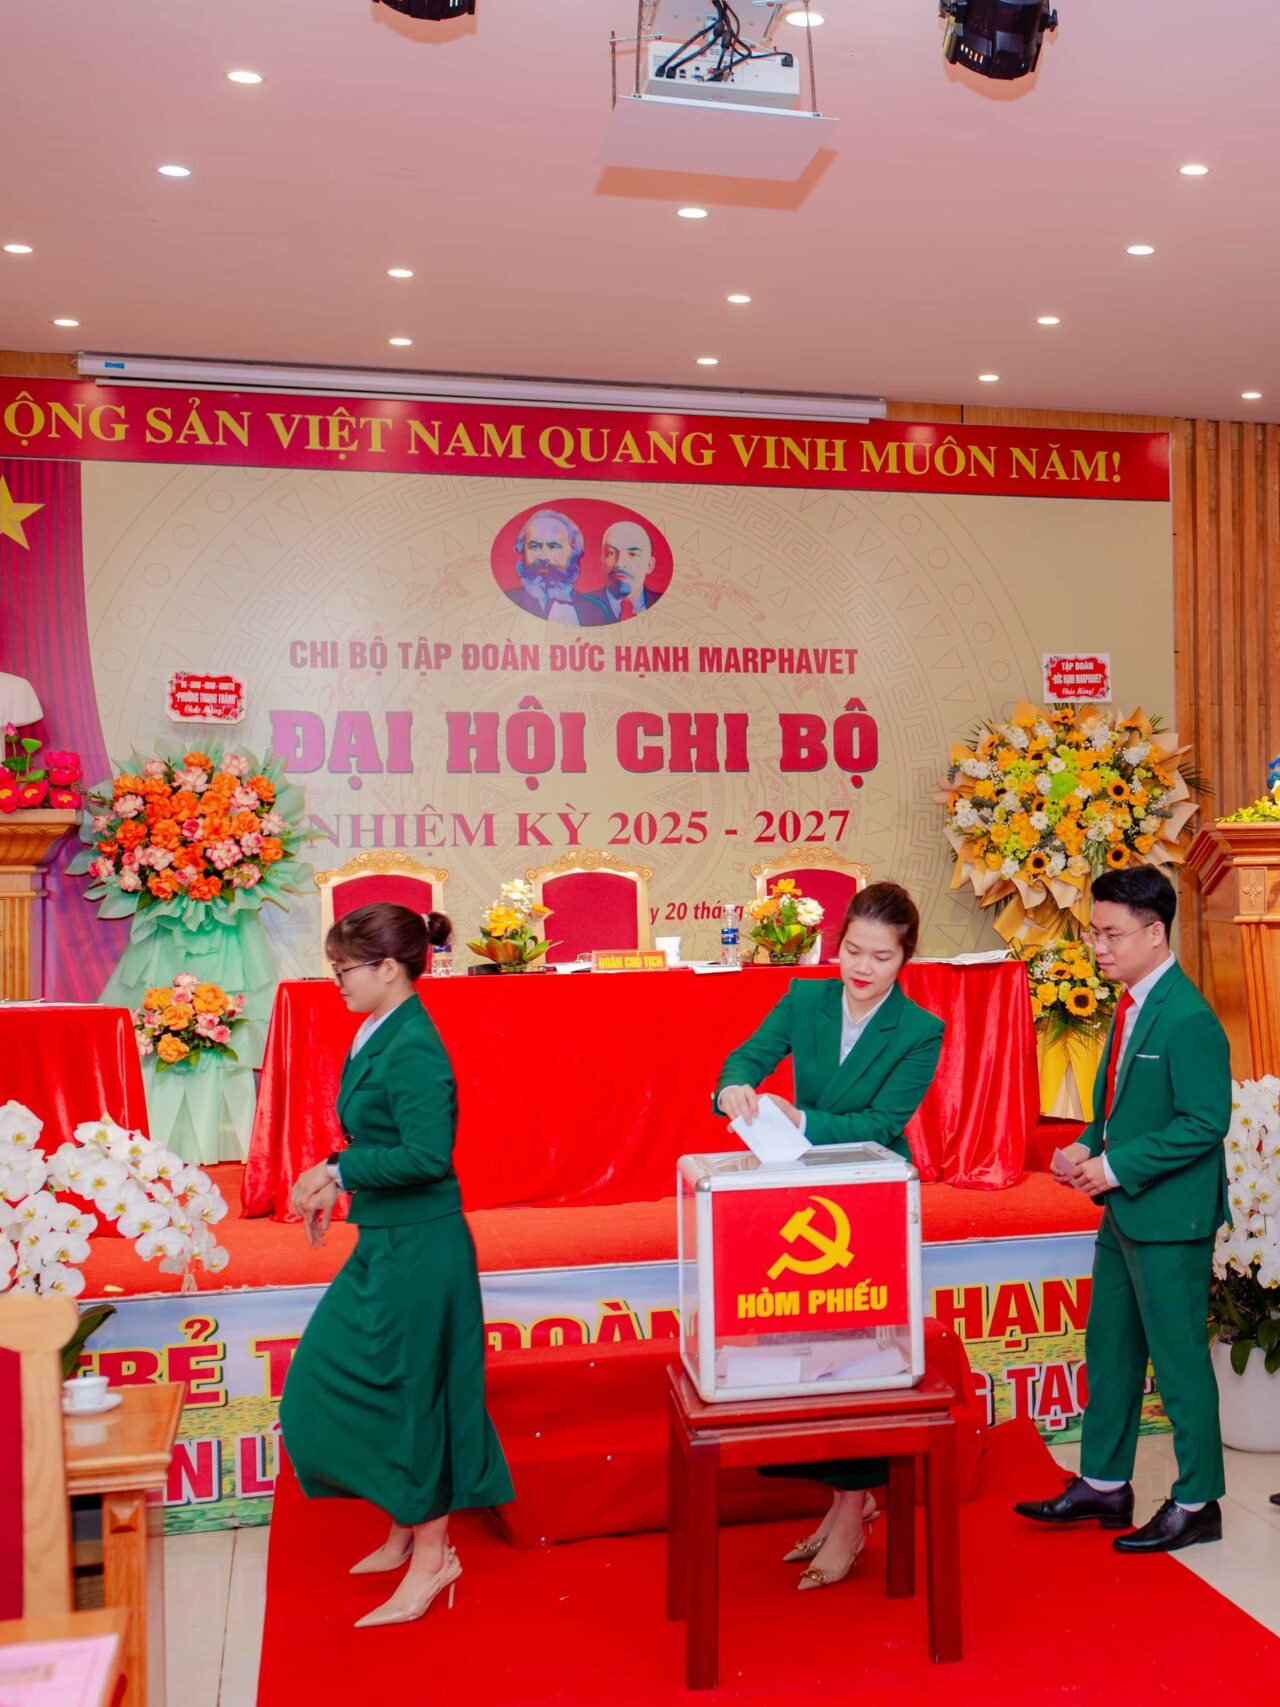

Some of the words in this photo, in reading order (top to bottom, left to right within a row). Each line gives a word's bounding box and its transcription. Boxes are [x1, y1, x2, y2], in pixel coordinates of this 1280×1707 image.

[0, 391, 130, 446] ỘNG
[145, 397, 250, 448] SẢN
[266, 406, 393, 460] VIỆT
[407, 419, 526, 459] NAM
[538, 425, 717, 469] QUANG
[730, 434, 848, 472] VINH
[860, 434, 1000, 477] MUÔN
[1009, 438, 1122, 483] NĂM!
[289, 641, 338, 669] CHI
[350, 636, 388, 676] BỘ
[397, 636, 452, 676] TẬP
[461, 638, 540, 671] ĐOÀN
[549, 637, 605, 673] ĐỨC
[615, 646, 689, 678] HẠNH
[701, 647, 858, 674] MARPHAVET
[269, 710, 414, 791] ĐẠI
[446, 695, 587, 791] HỘI
[616, 711, 749, 773] CHI
[778, 697, 878, 789] BỘ
[307, 804, 497, 857] NHIỆM
[515, 803, 592, 846] KỲ
[607, 811, 708, 845] 2025
[752, 810, 850, 843] 2027
[665, 902, 688, 921] 20
[694, 900, 744, 922] thág
[737, 1287, 799, 1319] HÒM
[808, 1278, 888, 1315] PHIẾU
[930, 1274, 1093, 1352] HẠN
